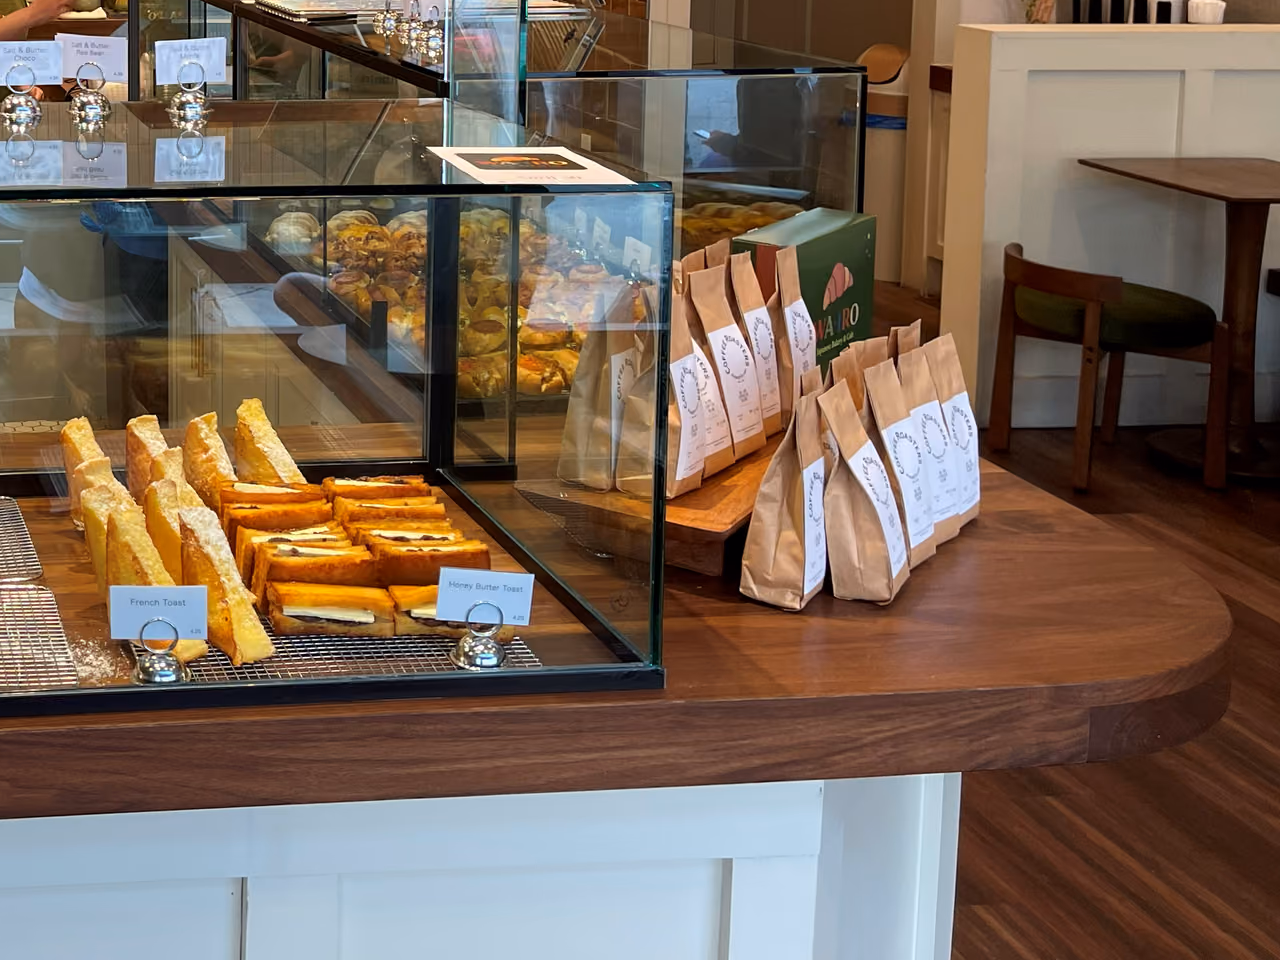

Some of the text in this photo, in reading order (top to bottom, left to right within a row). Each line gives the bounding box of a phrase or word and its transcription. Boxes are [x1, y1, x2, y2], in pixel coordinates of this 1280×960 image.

[448, 581, 523, 593] Honey Butter Toast
[130, 598, 186, 607] French Toast
